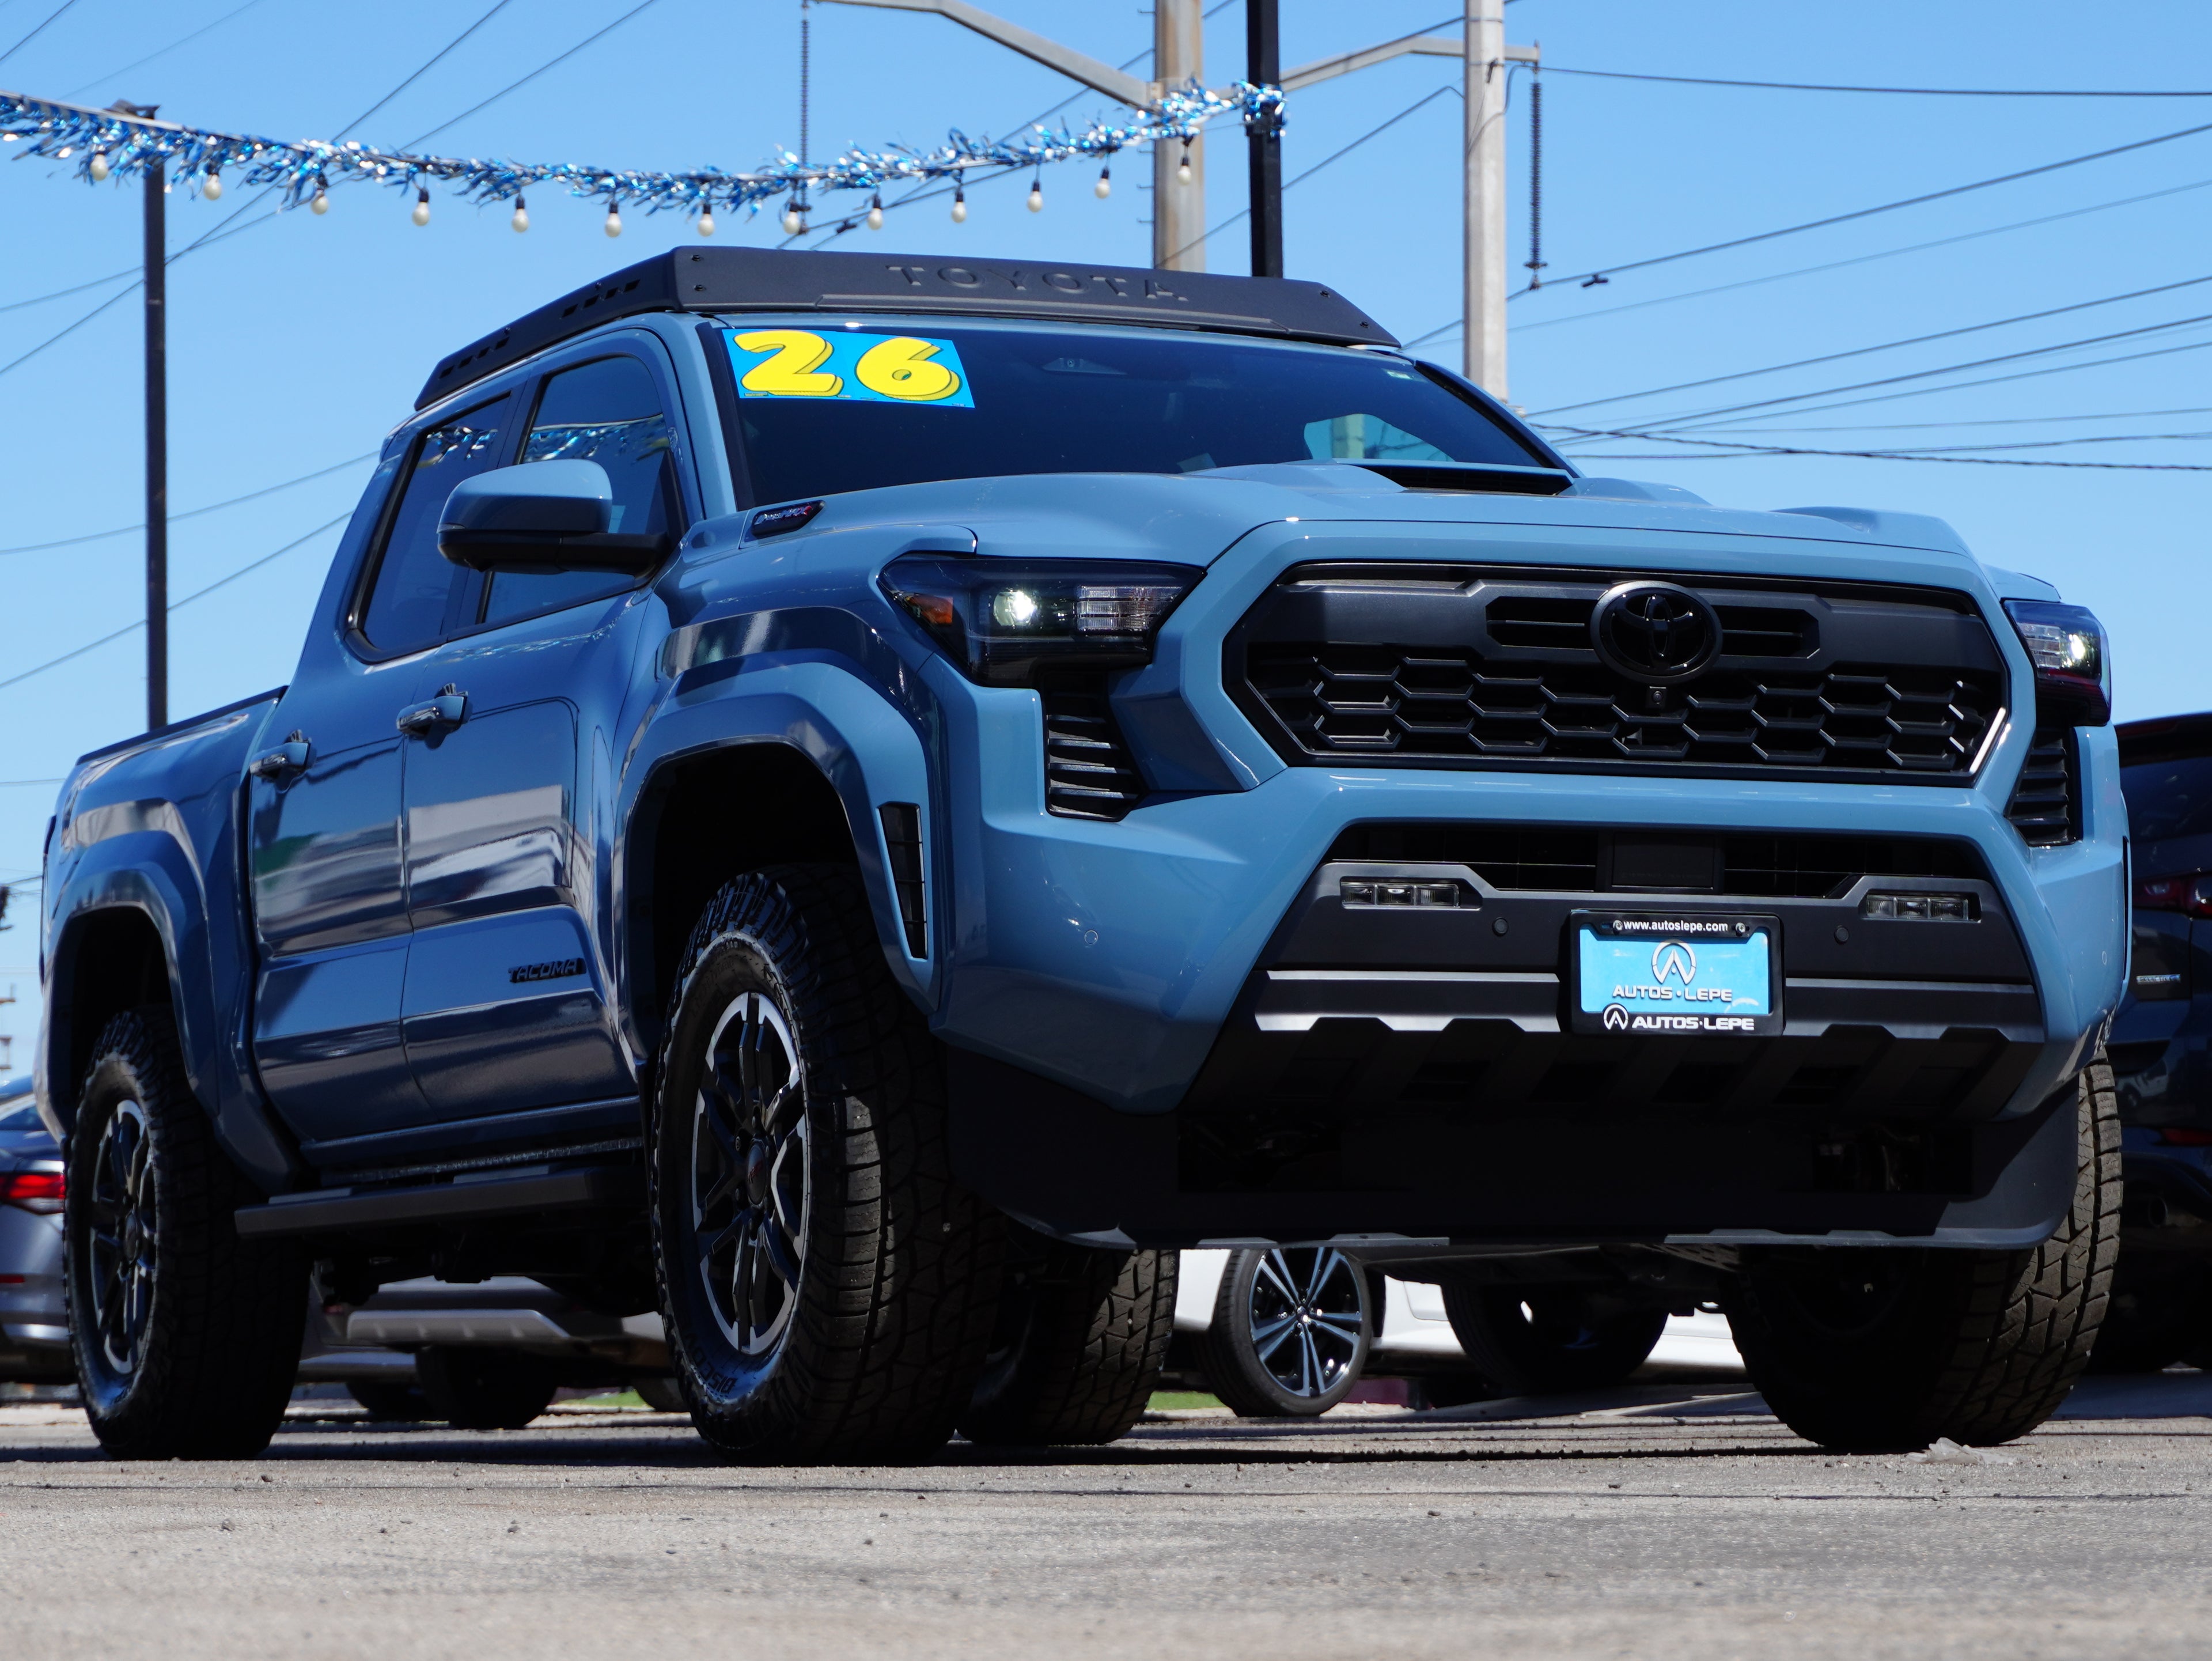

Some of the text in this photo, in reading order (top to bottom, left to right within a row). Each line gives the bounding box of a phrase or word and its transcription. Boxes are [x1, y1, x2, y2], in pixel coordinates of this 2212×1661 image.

[885, 264, 1189, 301] TOYOTA
[733, 330, 961, 401] 26
[1623, 920, 1728, 934] www.autoslepe.com
[508, 958, 586, 983] TACOMA
[1613, 984, 1733, 1002] AUTOS LEPE
